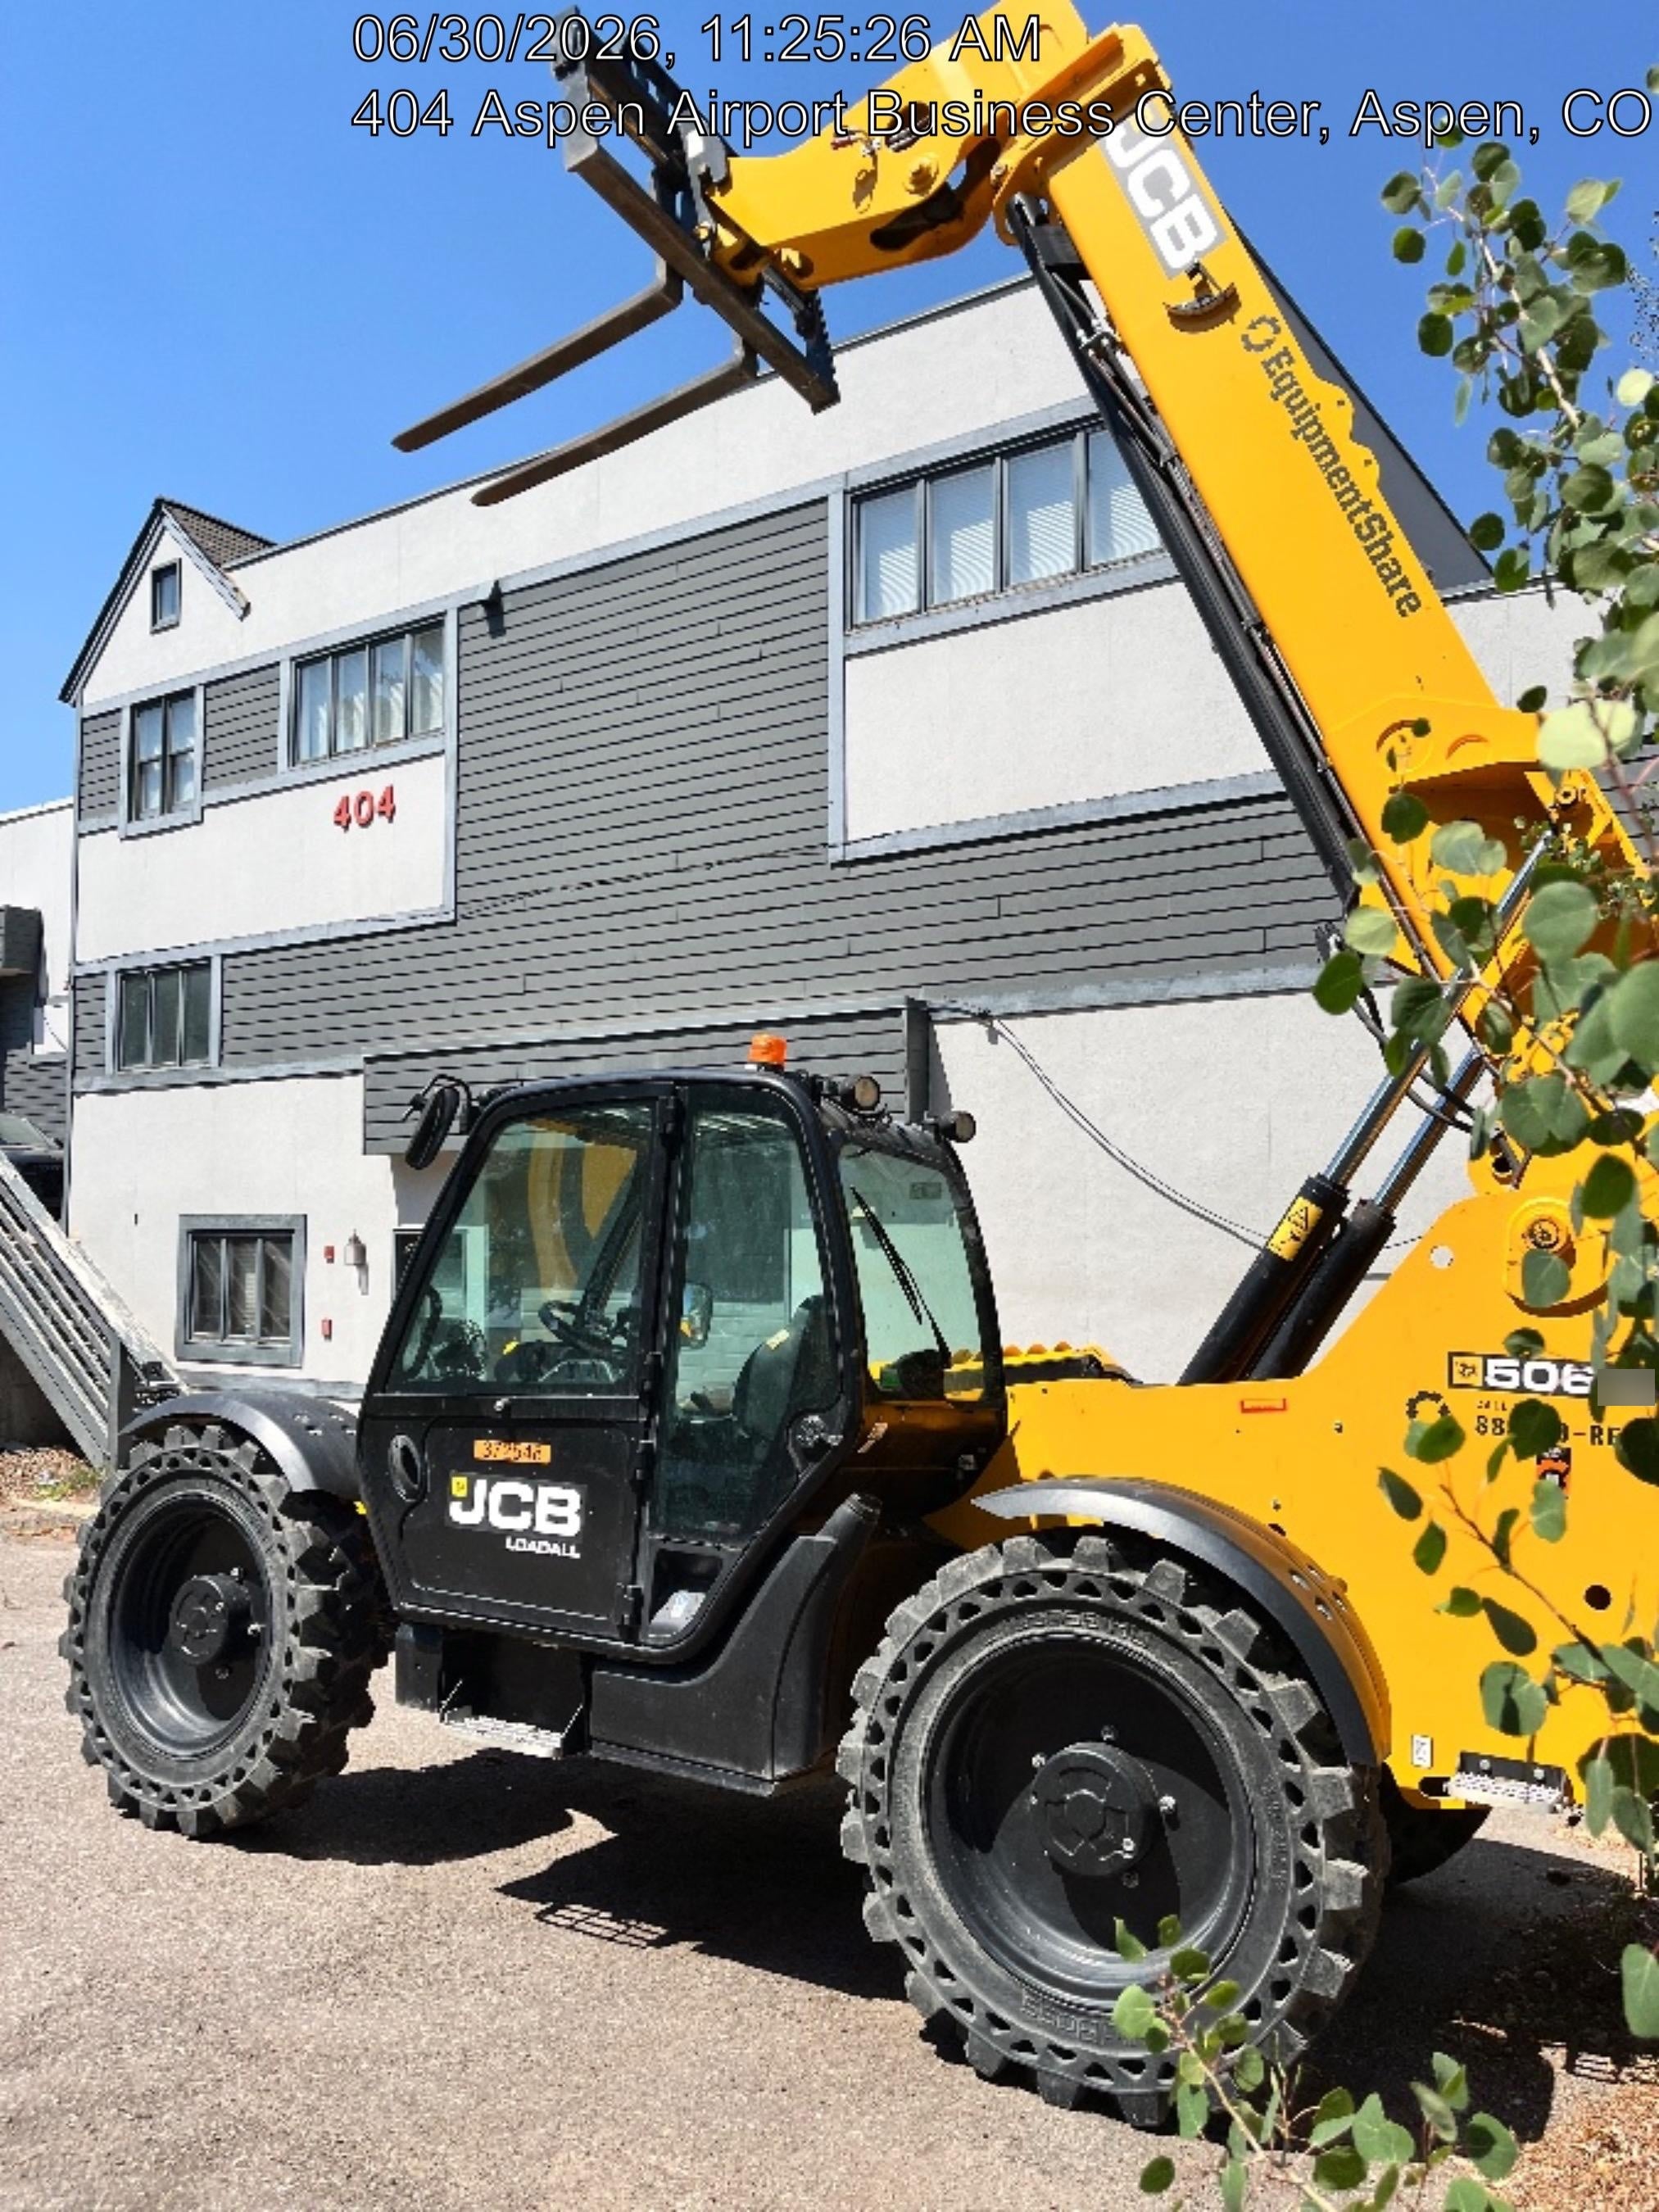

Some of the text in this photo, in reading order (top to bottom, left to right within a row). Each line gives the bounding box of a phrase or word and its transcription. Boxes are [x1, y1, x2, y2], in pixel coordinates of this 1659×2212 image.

[1105, 121, 1218, 269] JCB
[1260, 346, 1421, 618] EquipmentShare
[333, 783, 396, 833] 404
[449, 1479, 581, 1537] JCB
[505, 1535, 581, 1559] LOADALL
